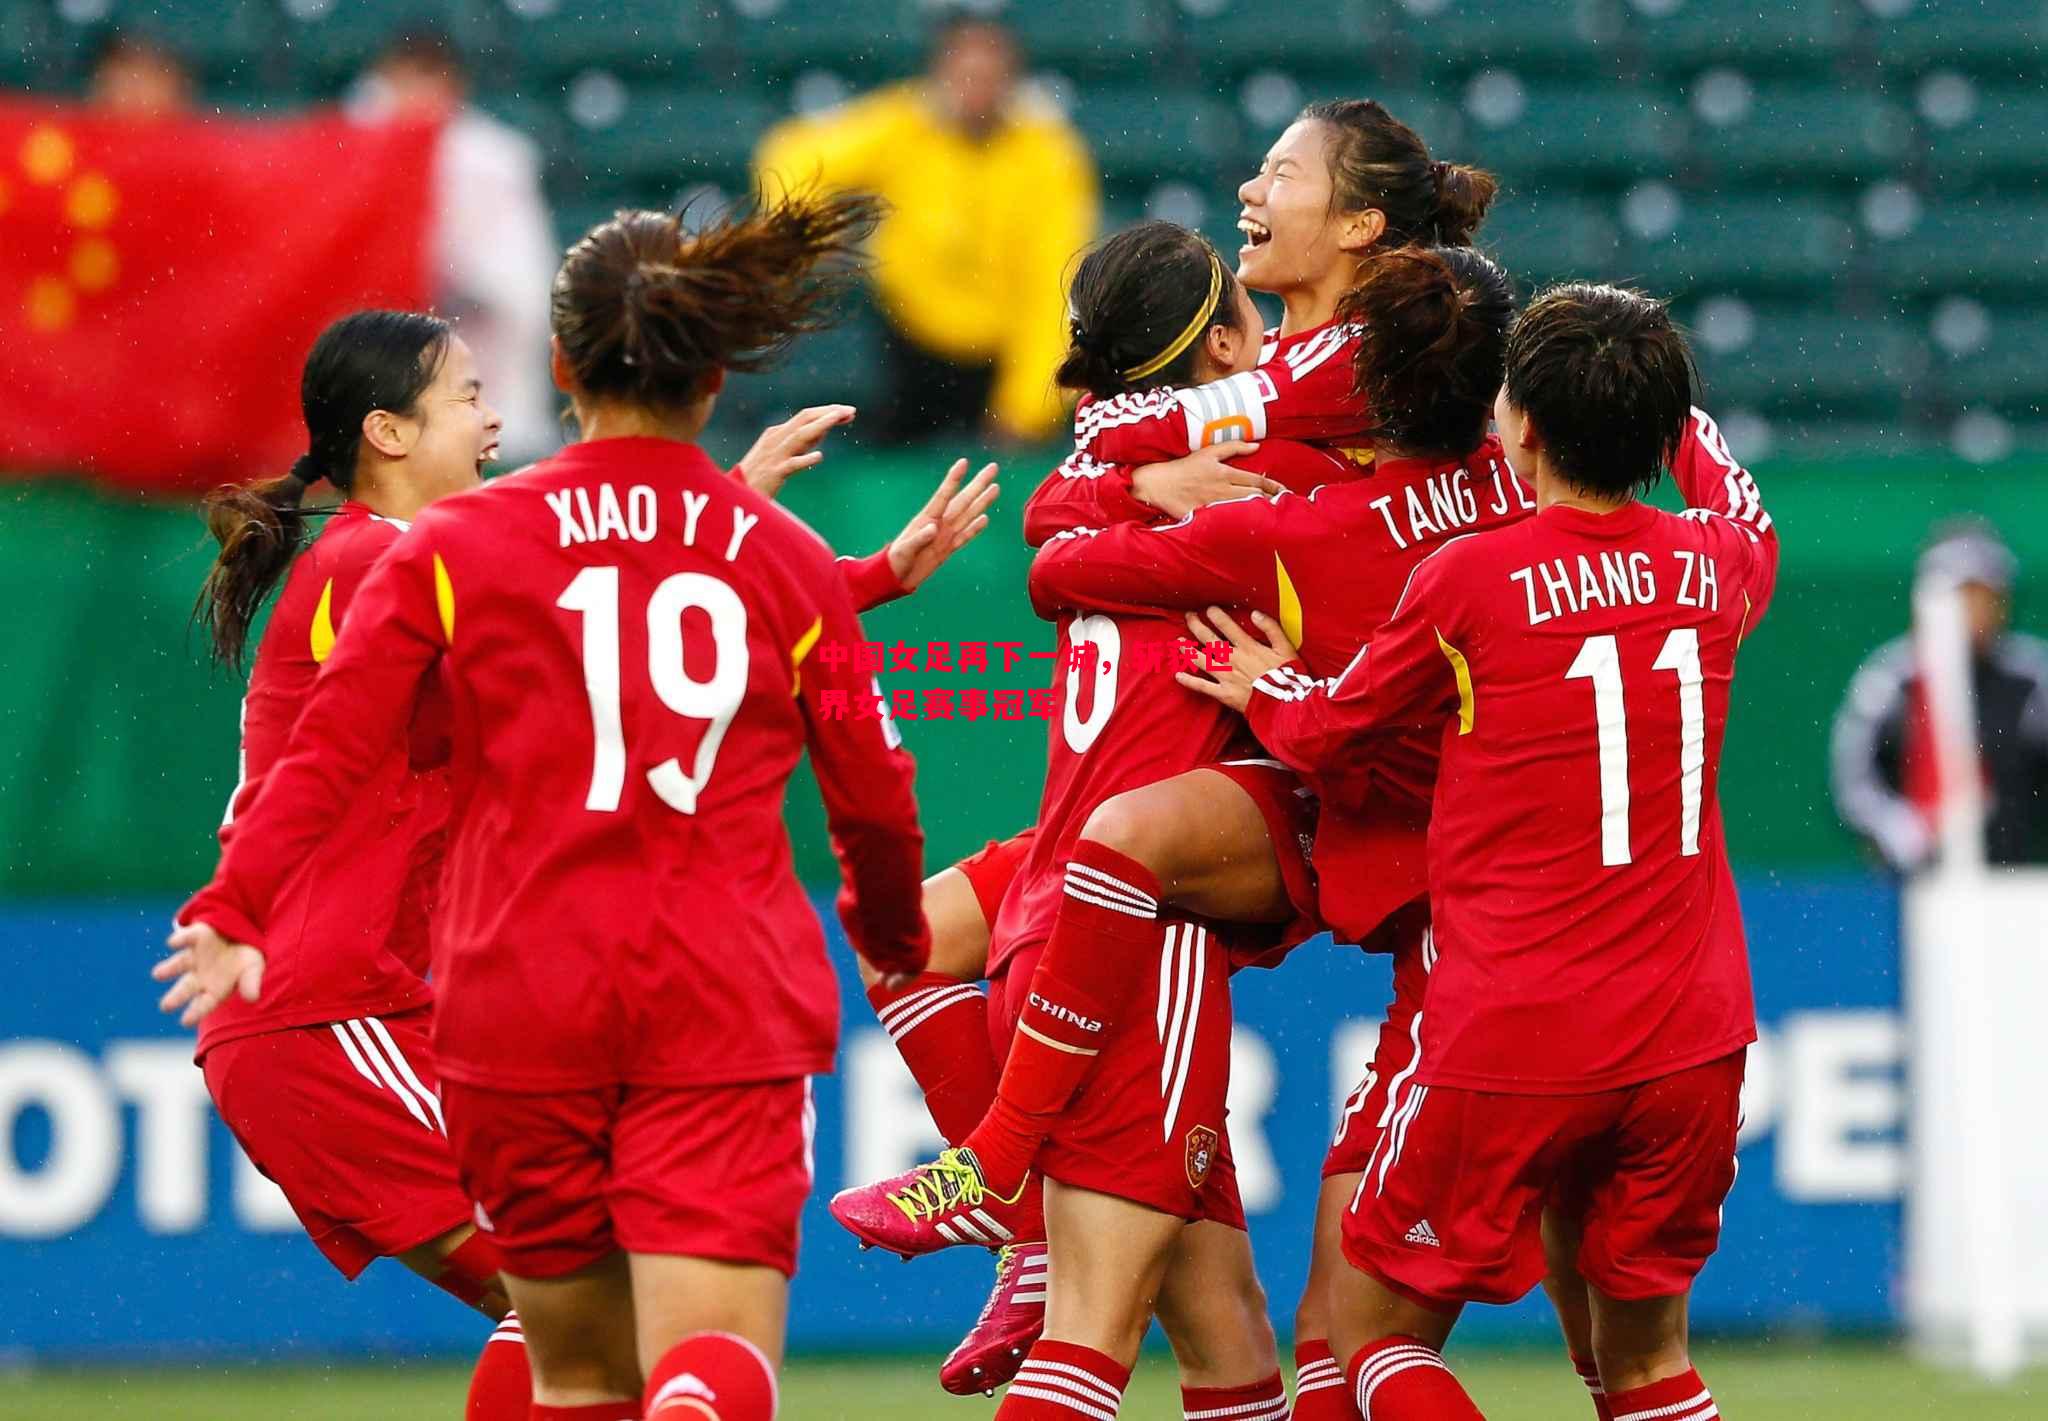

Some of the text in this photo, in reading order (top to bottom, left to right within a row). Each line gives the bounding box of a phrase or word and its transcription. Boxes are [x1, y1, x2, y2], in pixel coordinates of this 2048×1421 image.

[544, 483, 760, 562] XIAO Y Y
[1368, 467, 1478, 550] TANG
[1510, 550, 1720, 626] ZHANG ZH
[556, 564, 750, 816] 19
[1564, 628, 1705, 867] 11
[1404, 1233, 1441, 1247] adidas
